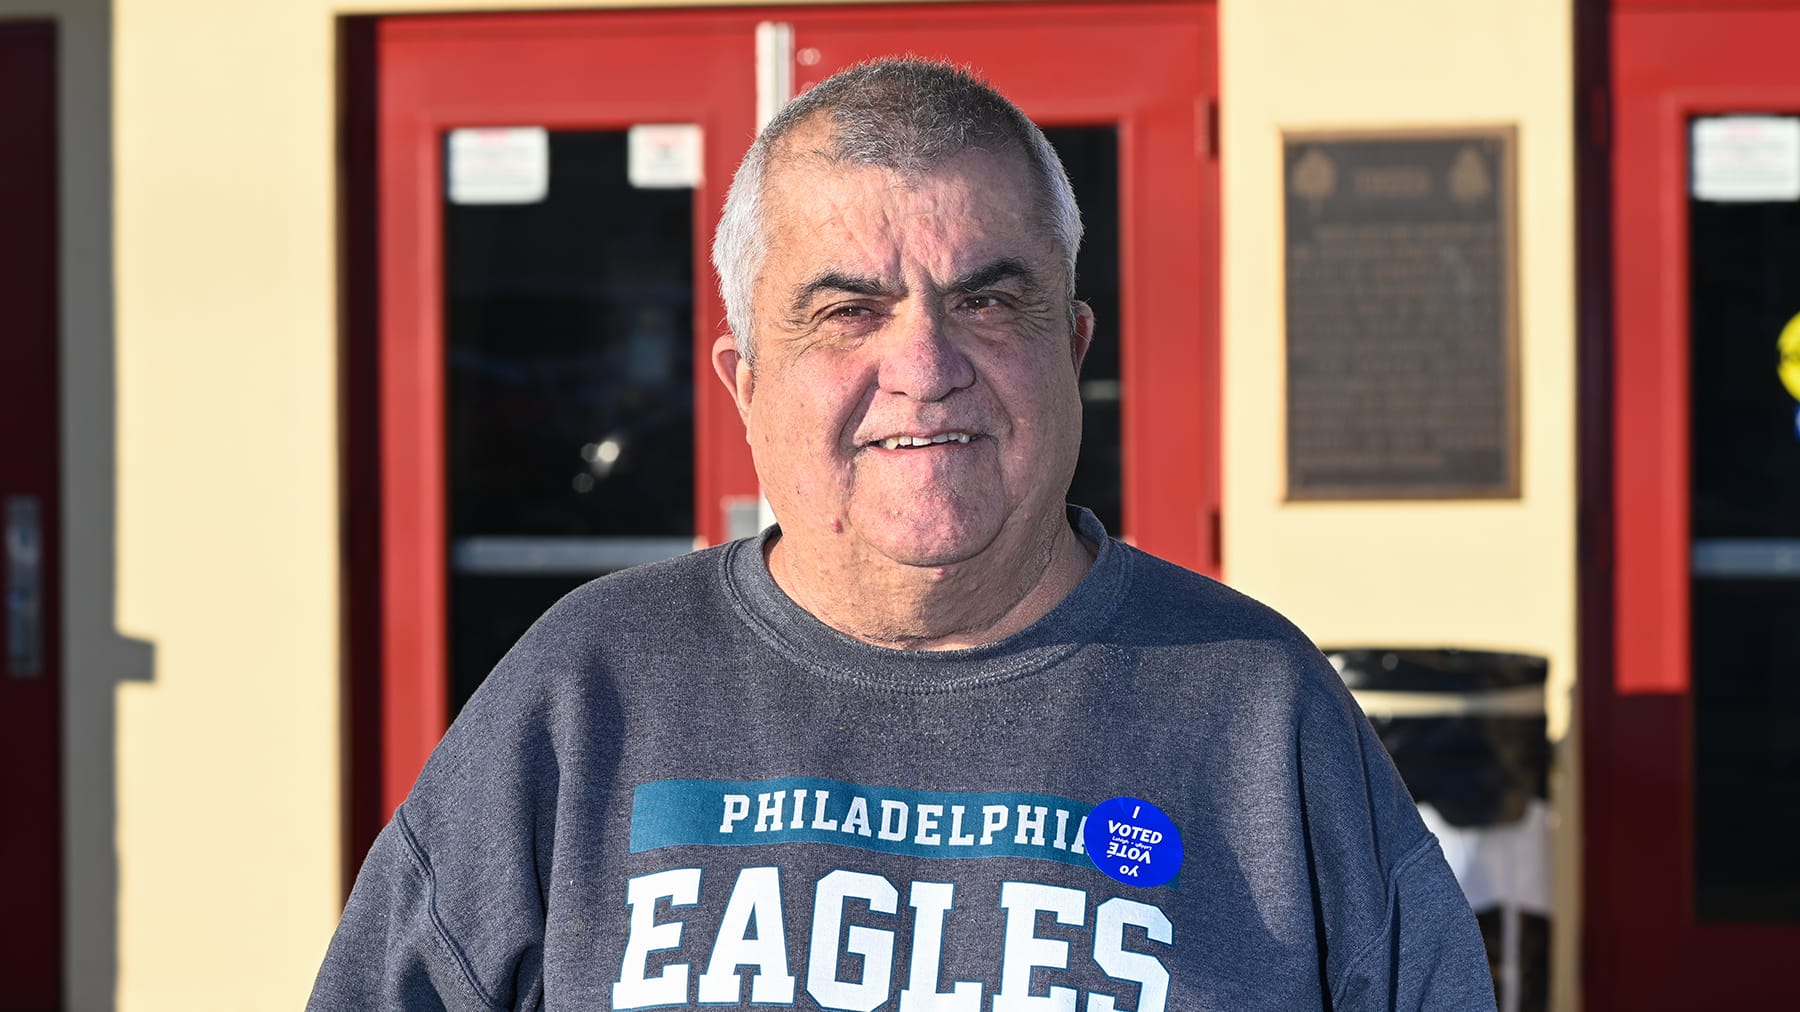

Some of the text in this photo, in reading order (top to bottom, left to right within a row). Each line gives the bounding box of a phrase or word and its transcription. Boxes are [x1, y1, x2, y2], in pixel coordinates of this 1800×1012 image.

[1132, 805, 1141, 819] I
[1108, 820, 1163, 844] VOTED
[1106, 842, 1151, 864] VOTÉ
[611, 866, 1174, 1012] EAGLES
